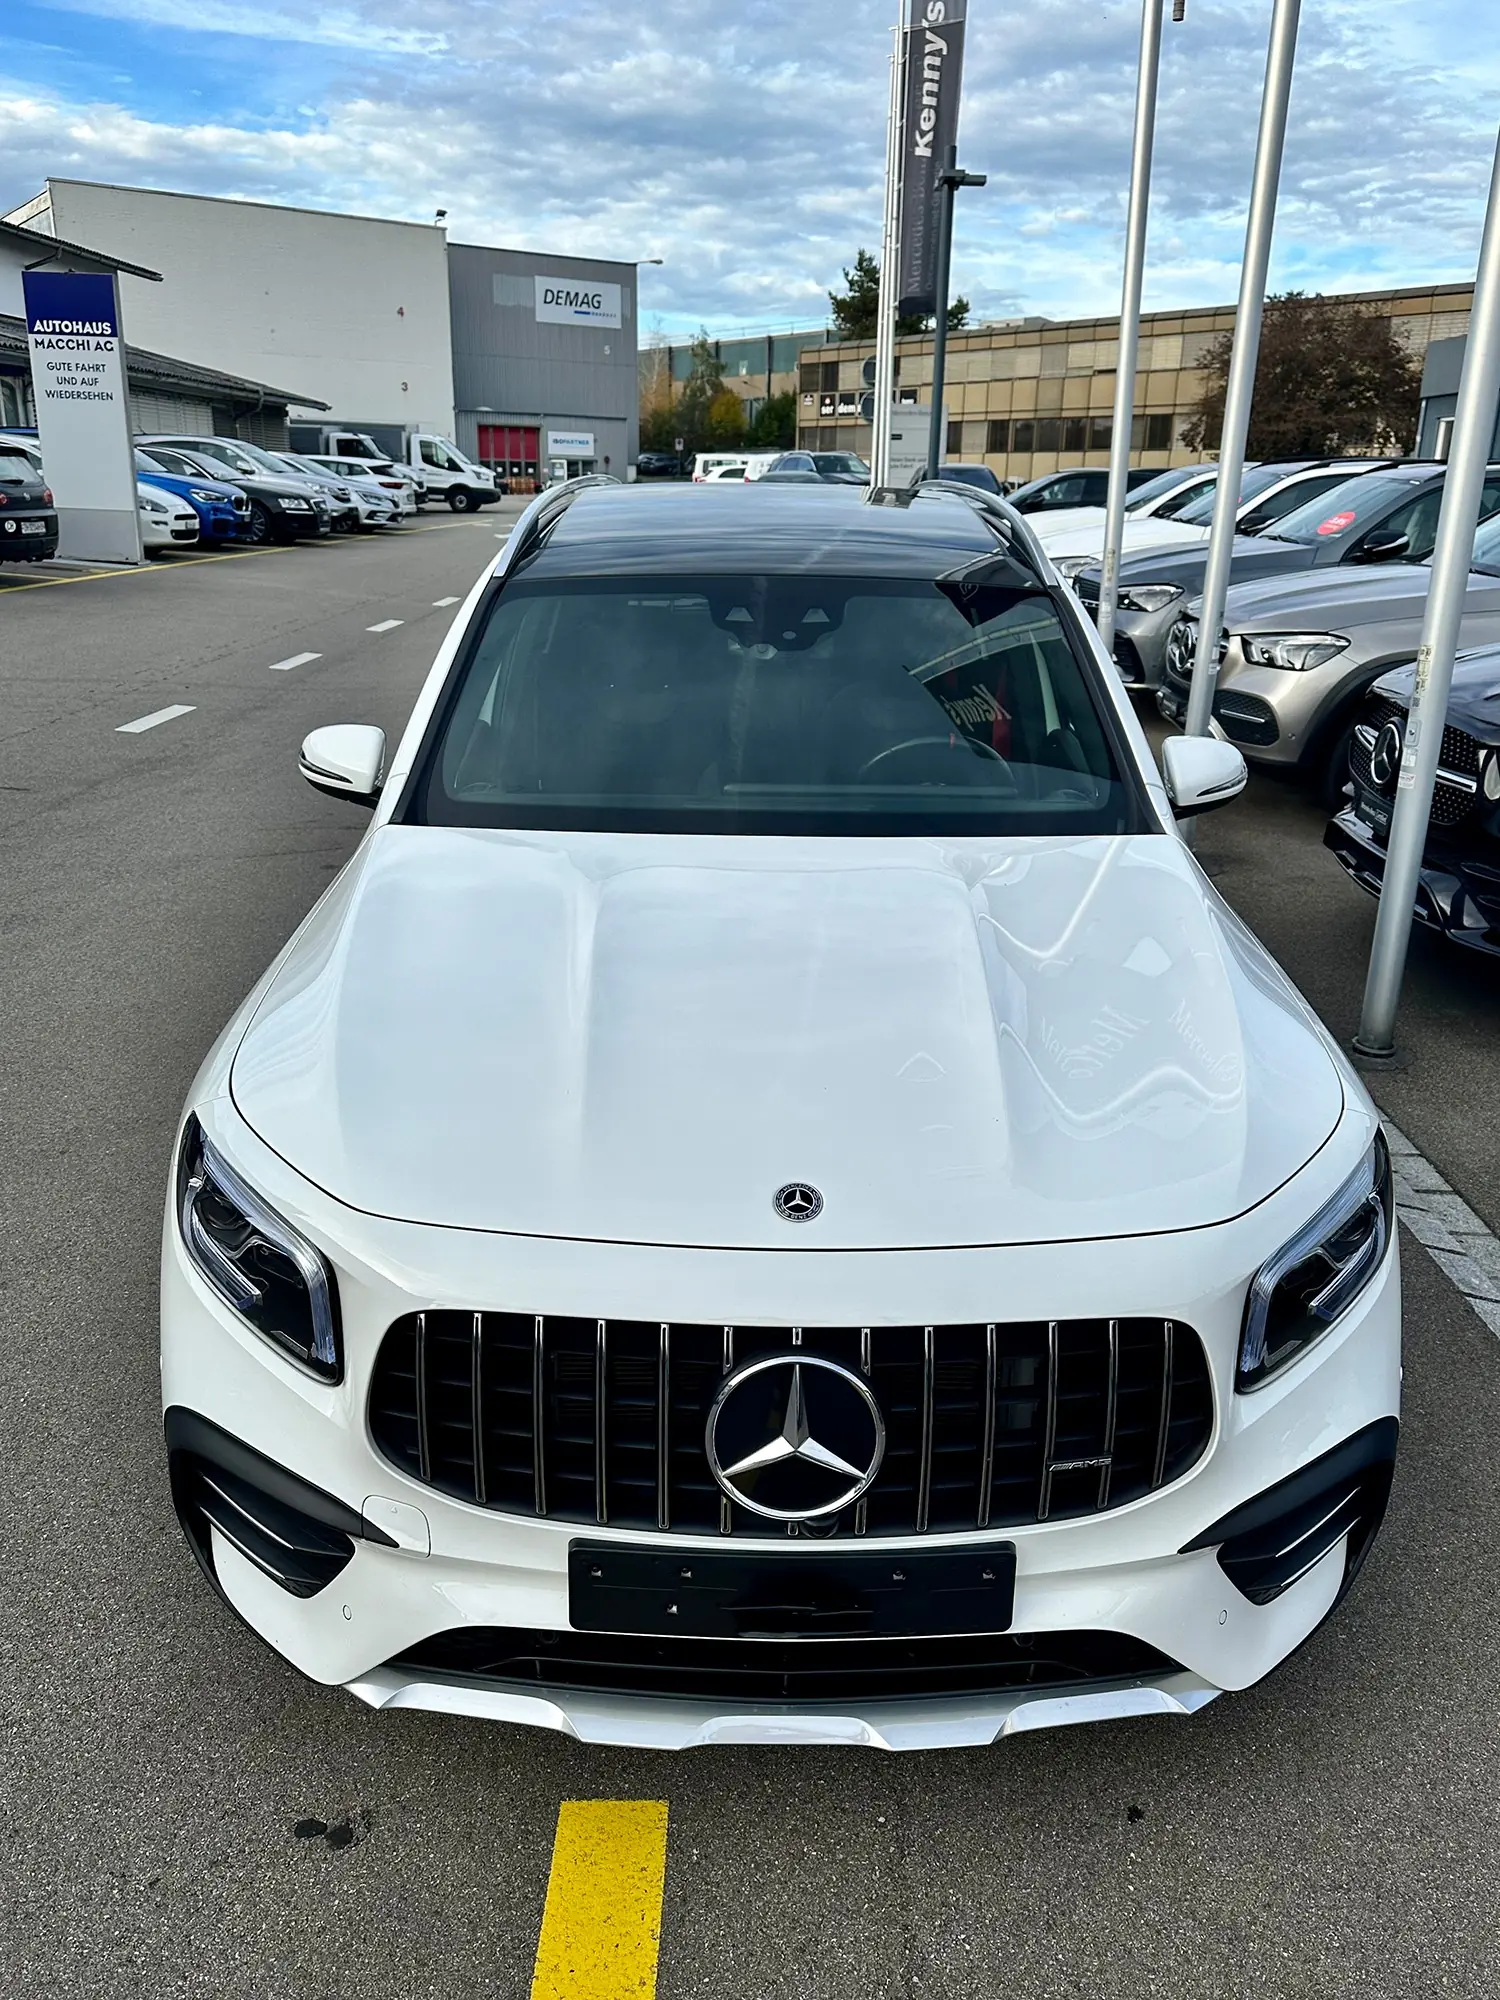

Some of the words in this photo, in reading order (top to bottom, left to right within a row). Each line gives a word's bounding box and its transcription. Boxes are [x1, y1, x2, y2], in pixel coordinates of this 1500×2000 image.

[914, 1, 948, 158] Kenny's
[543, 288, 603, 310] DEMAG
[396, 306, 405, 318] 4
[33, 319, 112, 335] AUTOHAUS
[34, 338, 91, 351] MACCHI
[94, 340, 114, 352] AG
[46, 361, 73, 372] GUTE
[75, 362, 106, 373] FAHRT
[56, 376, 78, 386] UND
[80, 377, 100, 387] AUF
[401, 381, 408, 392] 3
[44, 389, 114, 401] WIEDERSEHEN
